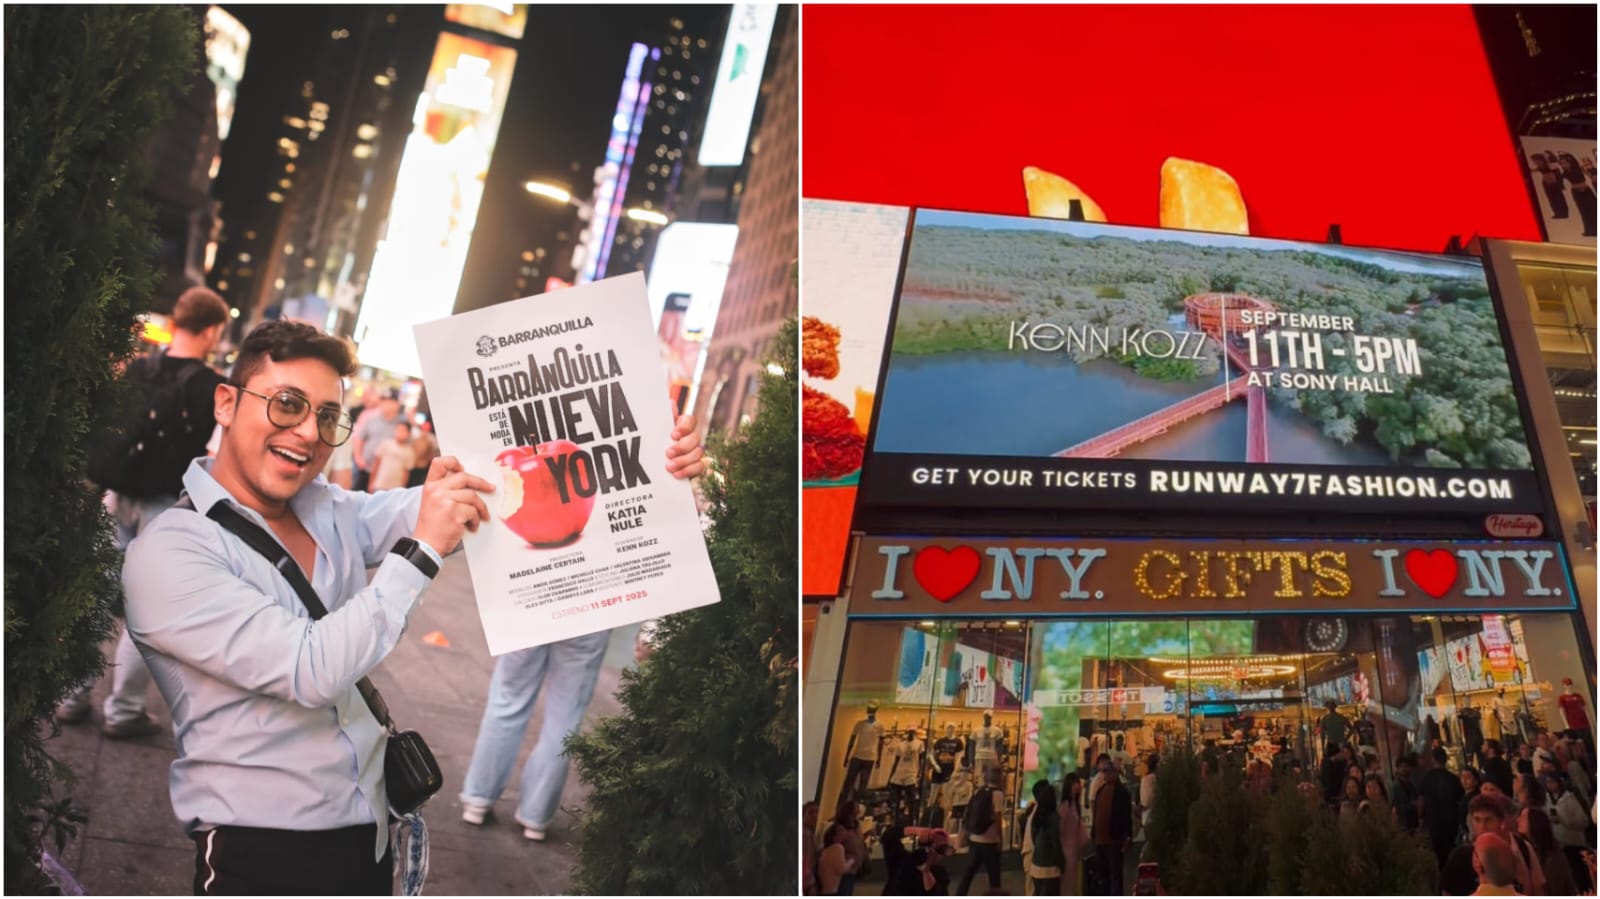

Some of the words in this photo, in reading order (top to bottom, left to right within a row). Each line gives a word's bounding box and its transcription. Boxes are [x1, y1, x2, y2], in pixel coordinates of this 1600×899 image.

[1240, 310, 1354, 331] SEPTEMBER
[498, 316, 594, 348] BARRANQUILLA
[1007, 321, 1109, 354] KENN
[1122, 329, 1207, 361] KOZZ
[1244, 329, 1324, 370] 11TH
[1354, 335, 1422, 376] 5PM
[489, 360, 521, 371] PRESENTA
[1247, 371, 1272, 387] AT
[1281, 373, 1336, 390] SONY
[1344, 376, 1393, 393] HALL
[489, 408, 506, 422] ESTÁ
[499, 420, 509, 429] DE
[508, 381, 638, 447] NUEVA
[490, 429, 511, 440] MODA
[503, 437, 514, 446] EN
[544, 436, 651, 504] YORK
[911, 468, 959, 485] GET
[968, 469, 1033, 486] YOUR
[1042, 471, 1137, 488] TICKETS
[1150, 470, 1512, 499] RUNWAY7FASHION.COM
[605, 493, 653, 510] DIRECTORA
[607, 504, 647, 522] KATIA
[610, 517, 643, 533] NULE
[1490, 515, 1538, 536] Heritage
[616, 543, 637, 553] KENN
[638, 538, 658, 547] KOZZ
[509, 564, 552, 579] MADELAINE
[554, 556, 585, 568] CERTAIN
[872, 545, 910, 599] I
[1134, 550, 1351, 599] GIFTS
[1373, 549, 1405, 597] I
[590, 602, 599, 610] 11
[600, 596, 623, 607] SEPT
[625, 590, 648, 601] 2025
